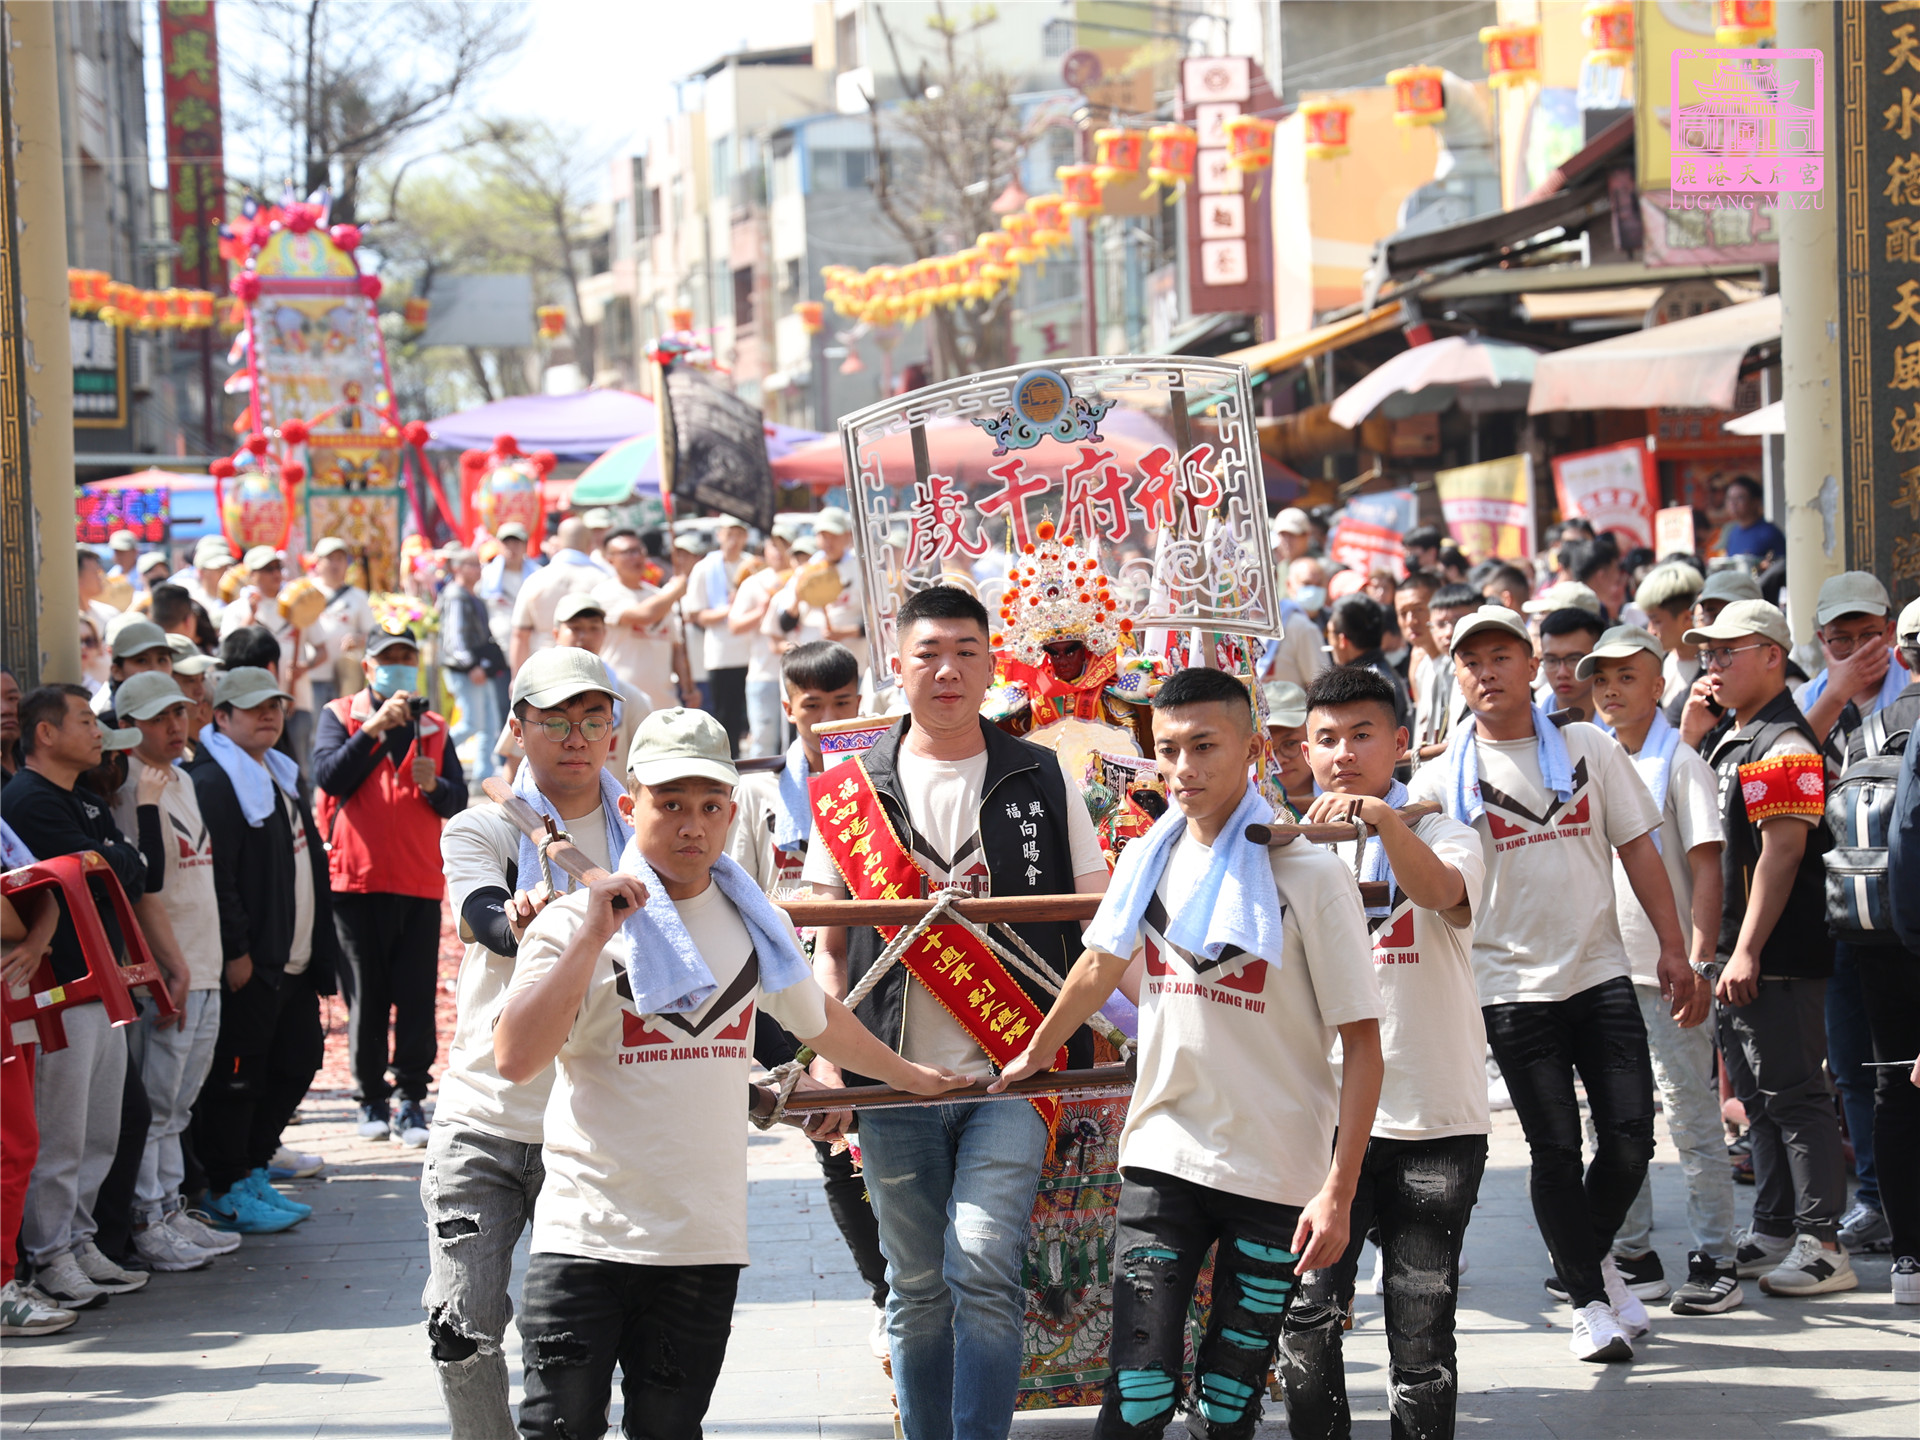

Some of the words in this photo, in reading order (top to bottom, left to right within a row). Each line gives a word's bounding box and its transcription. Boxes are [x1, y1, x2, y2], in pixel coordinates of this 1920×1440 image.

[1495, 842, 1505, 853] FU
[1506, 837, 1527, 851] XING
[1528, 831, 1557, 847] XIANG
[1558, 827, 1579, 839] YANG
[1372, 953, 1395, 964] ANG
[1398, 952, 1420, 964] HUI
[1149, 982, 1157, 994] FU
[1174, 982, 1208, 998] XIANG
[1210, 989, 1243, 1008] YANG
[1244, 999, 1266, 1014] HUI
[618, 1053, 634, 1065] FU
[636, 1049, 668, 1063] XING
[670, 1046, 709, 1060] XIANG
[711, 1045, 737, 1058] YANG
